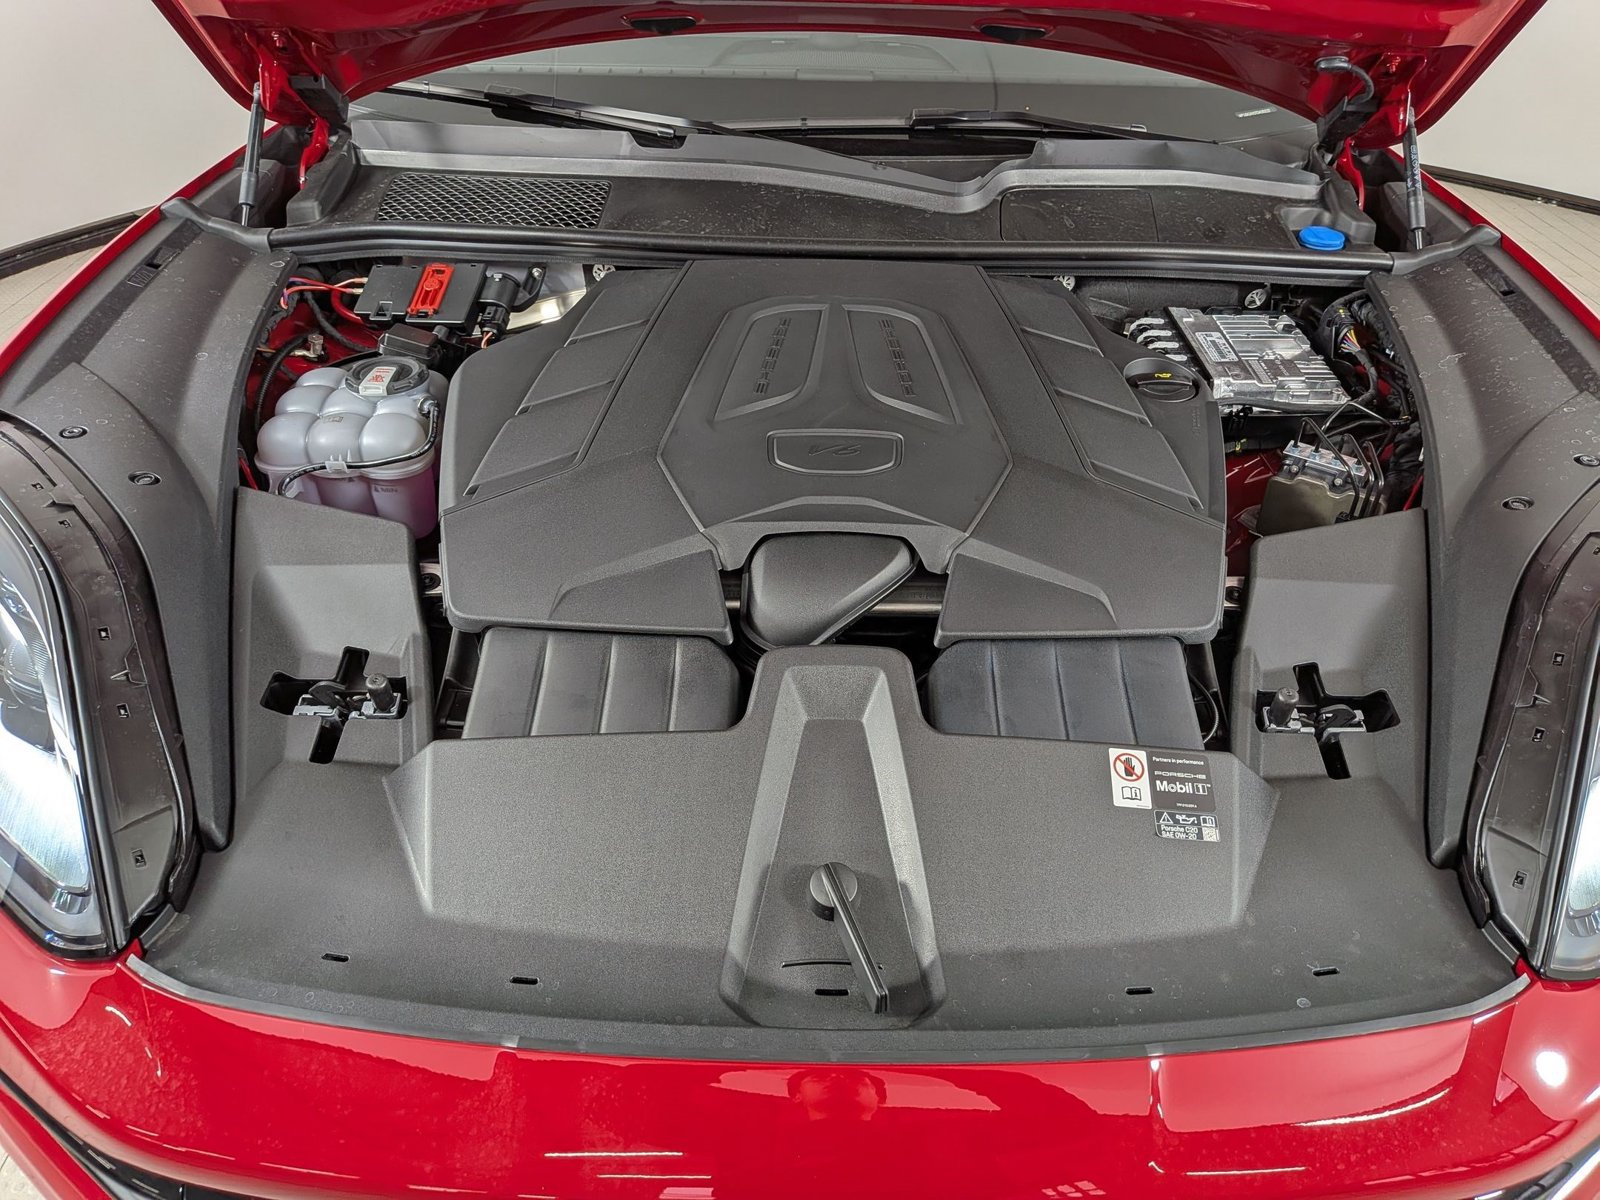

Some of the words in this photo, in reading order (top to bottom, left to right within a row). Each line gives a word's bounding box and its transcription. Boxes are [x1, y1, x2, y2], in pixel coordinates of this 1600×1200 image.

[1154, 771, 1206, 780] PORSCHE
[1155, 780, 1193, 794] Mobil
[1161, 824, 1185, 833] Porsche
[1185, 826, 1199, 834] C20
[1161, 831, 1175, 839] SAE
[1175, 832, 1197, 840] 0W-20
